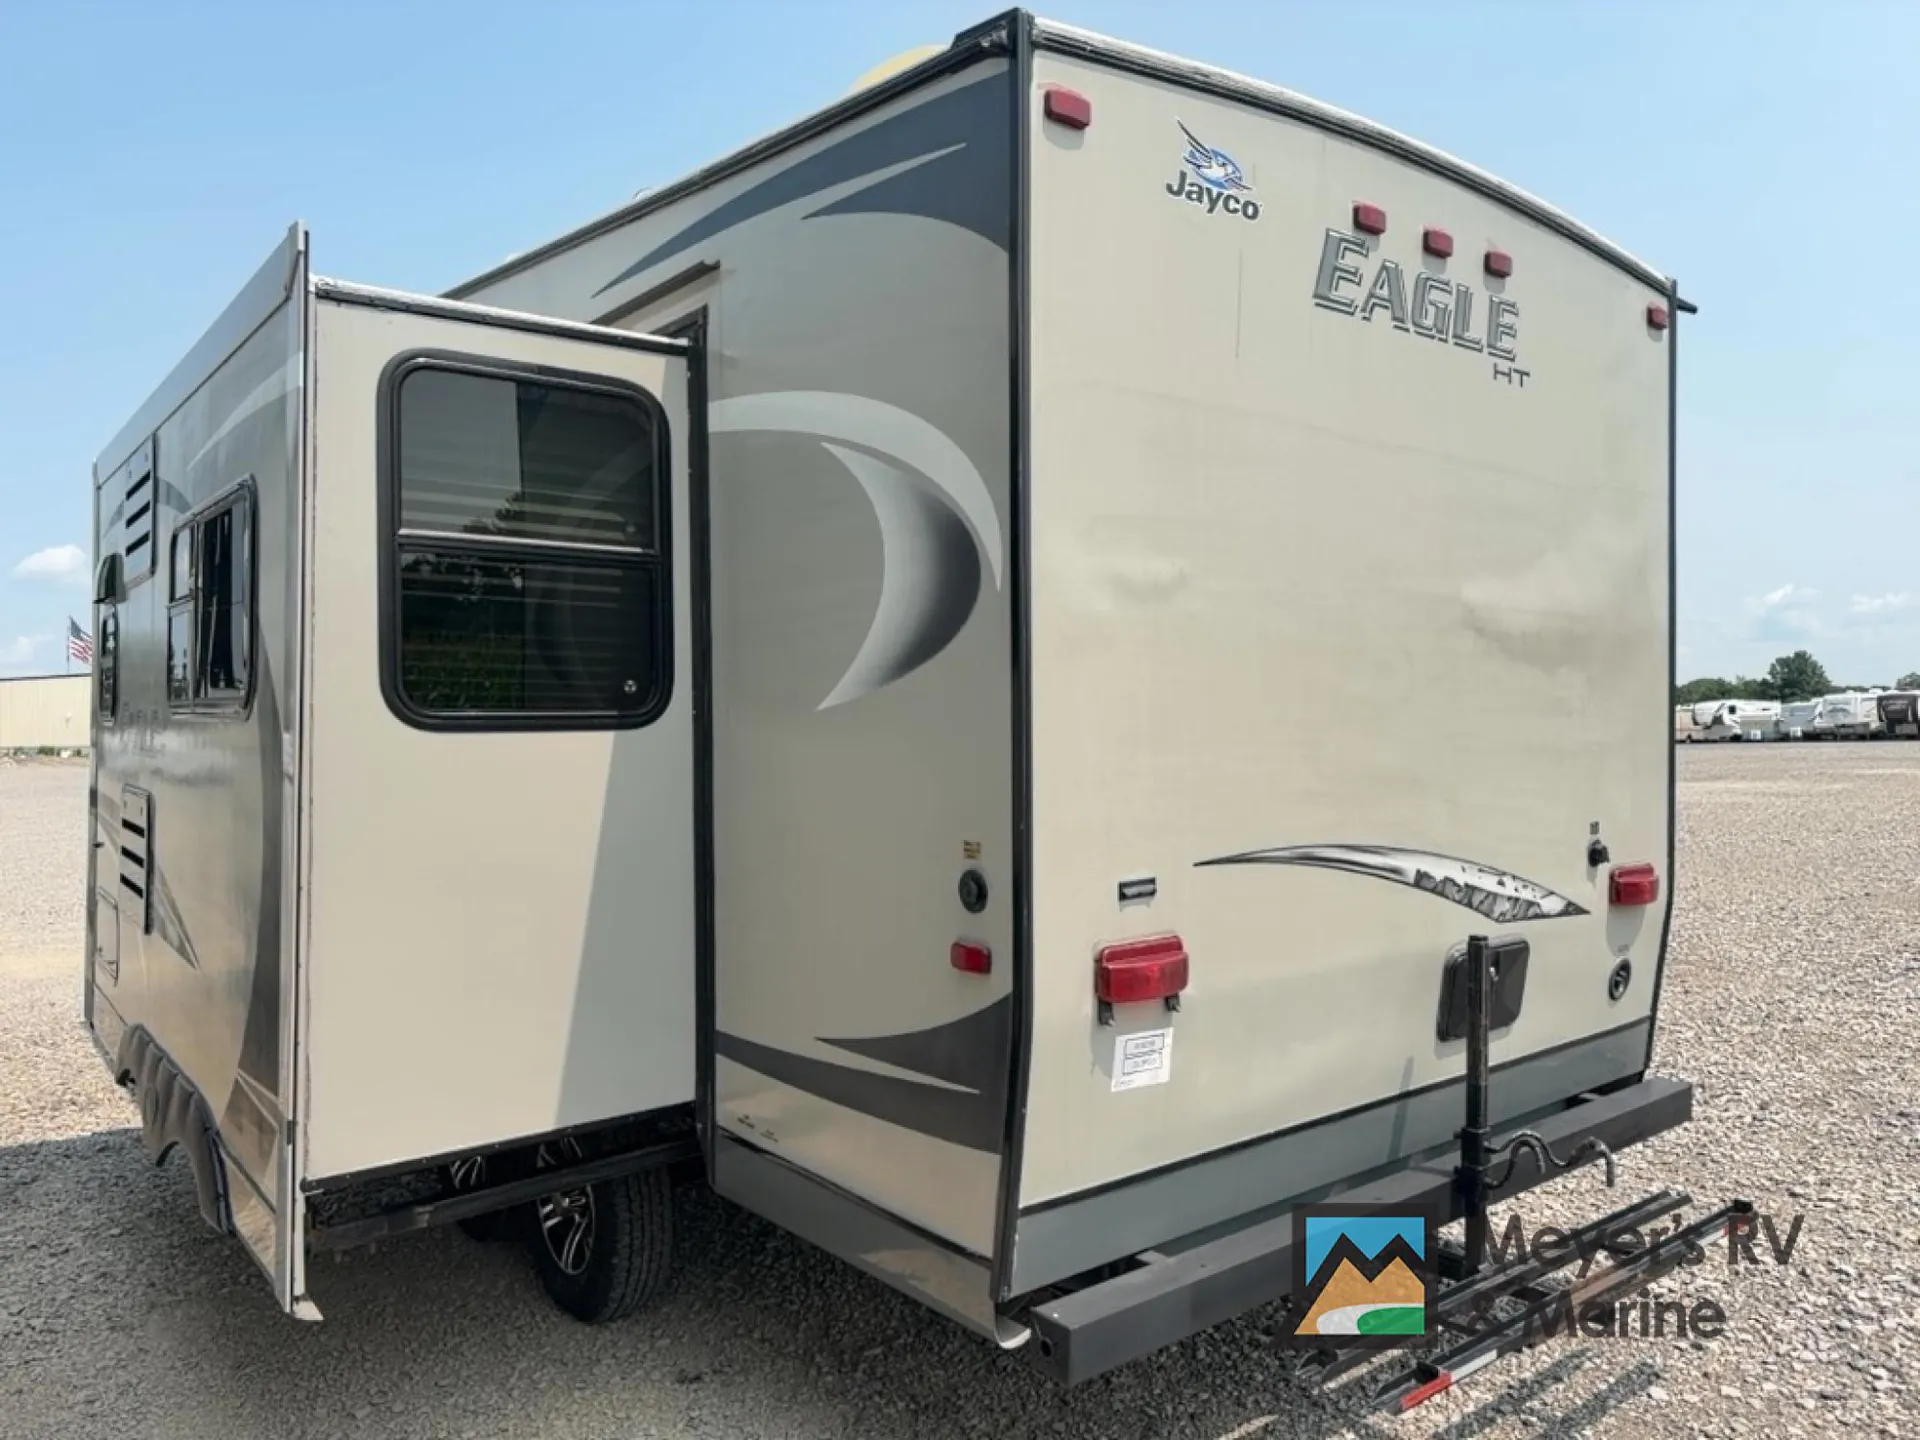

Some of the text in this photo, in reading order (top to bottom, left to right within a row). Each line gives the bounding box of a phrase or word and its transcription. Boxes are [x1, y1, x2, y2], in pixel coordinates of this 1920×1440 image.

[1166, 170, 1260, 220] Jayco
[1313, 228, 1519, 361] EAGLE
[1493, 363, 1530, 387] HT
